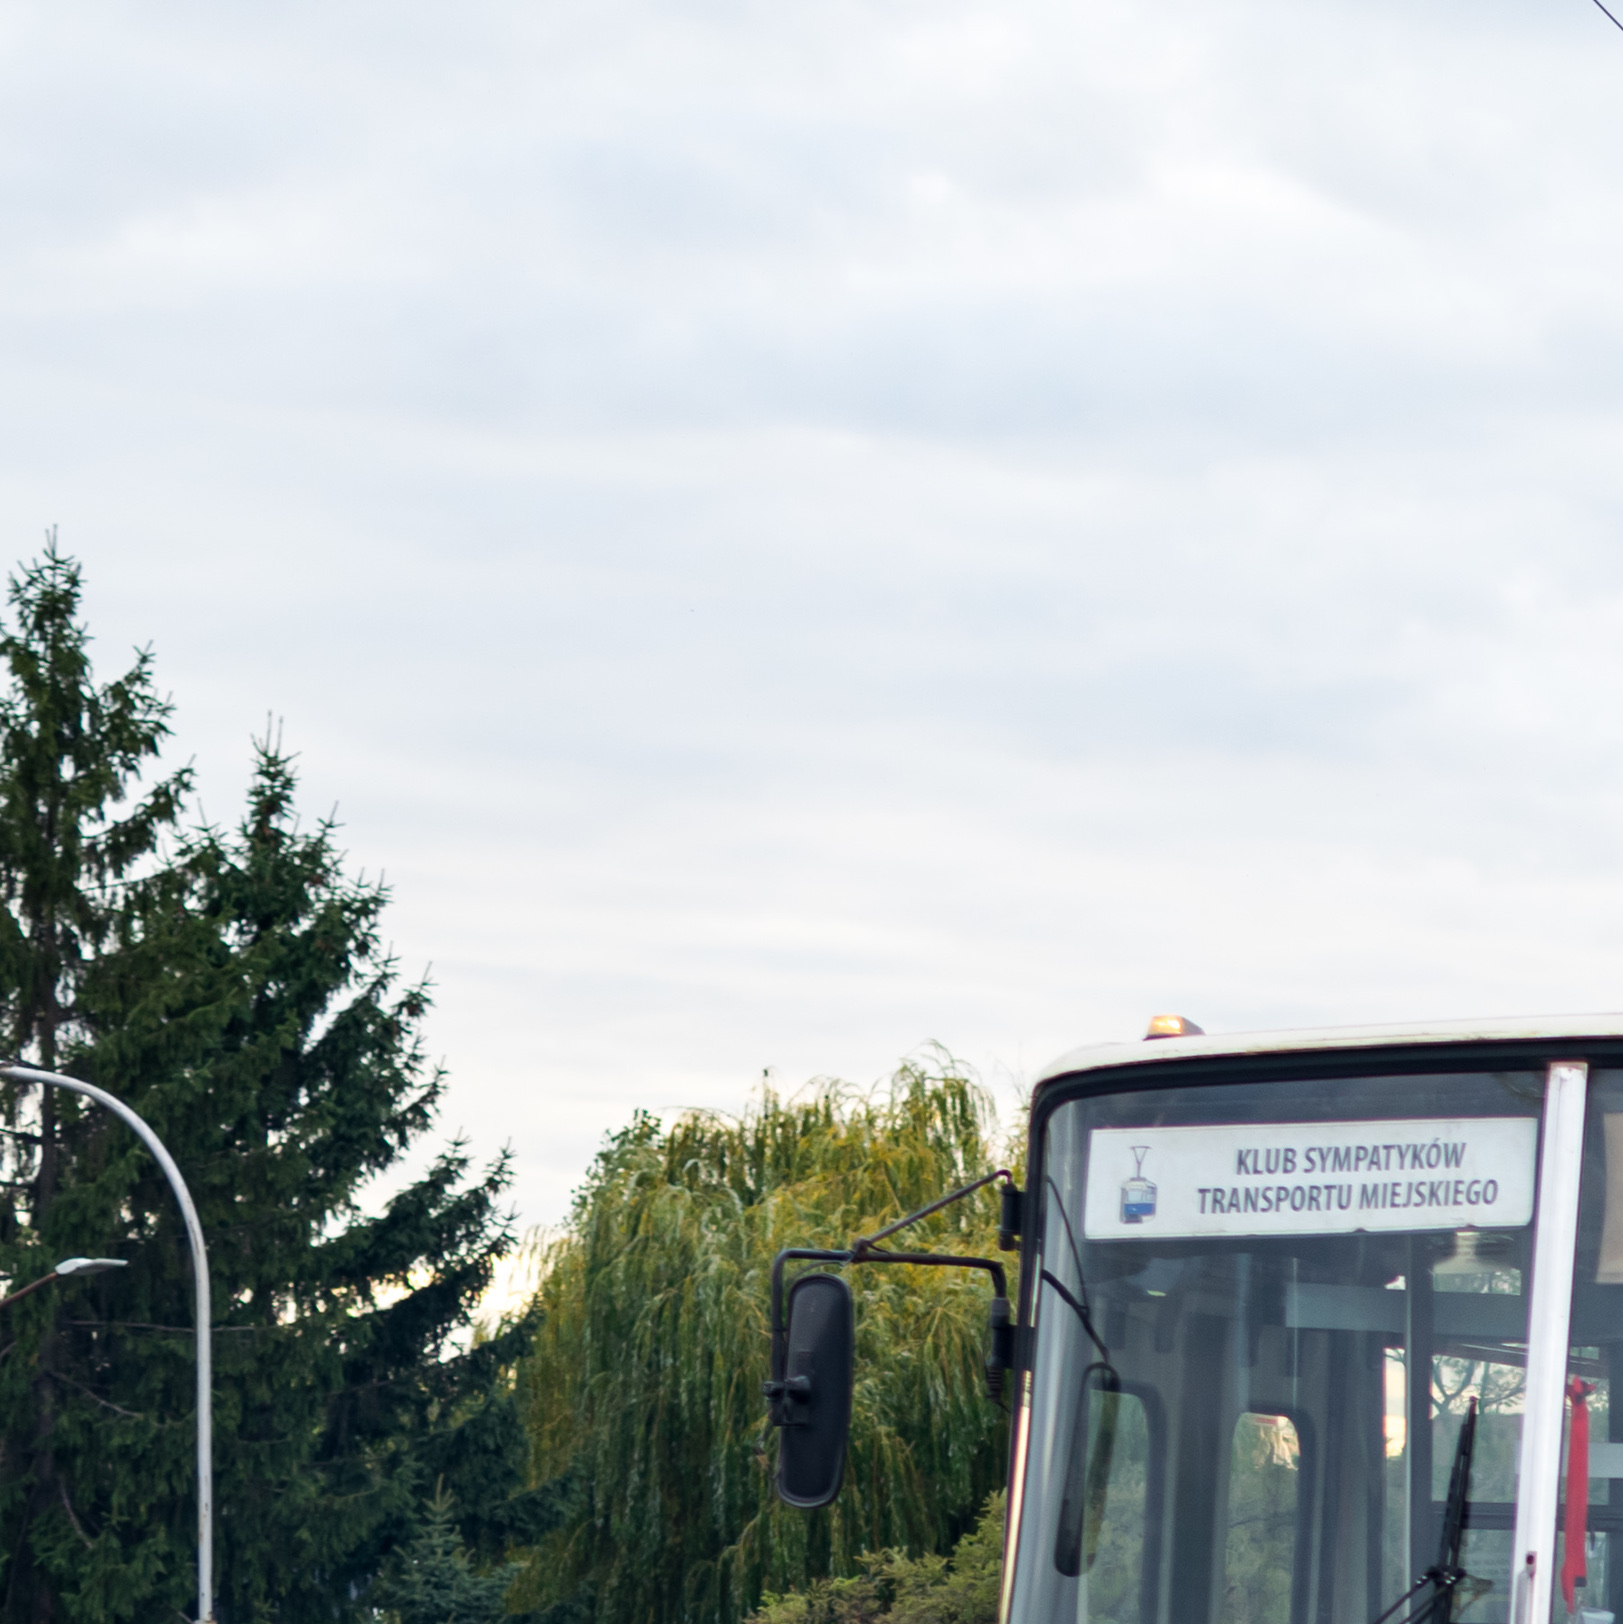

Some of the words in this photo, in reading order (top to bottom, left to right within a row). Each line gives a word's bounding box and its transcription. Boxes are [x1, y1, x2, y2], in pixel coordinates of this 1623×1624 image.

[1236, 1147, 1297, 1176] KLUB
[1304, 1137, 1467, 1174] SYMPATYKÓW
[1198, 1184, 1352, 1215] TRANSPORTU
[1358, 1179, 1498, 1211] MIEJSKIEGO
